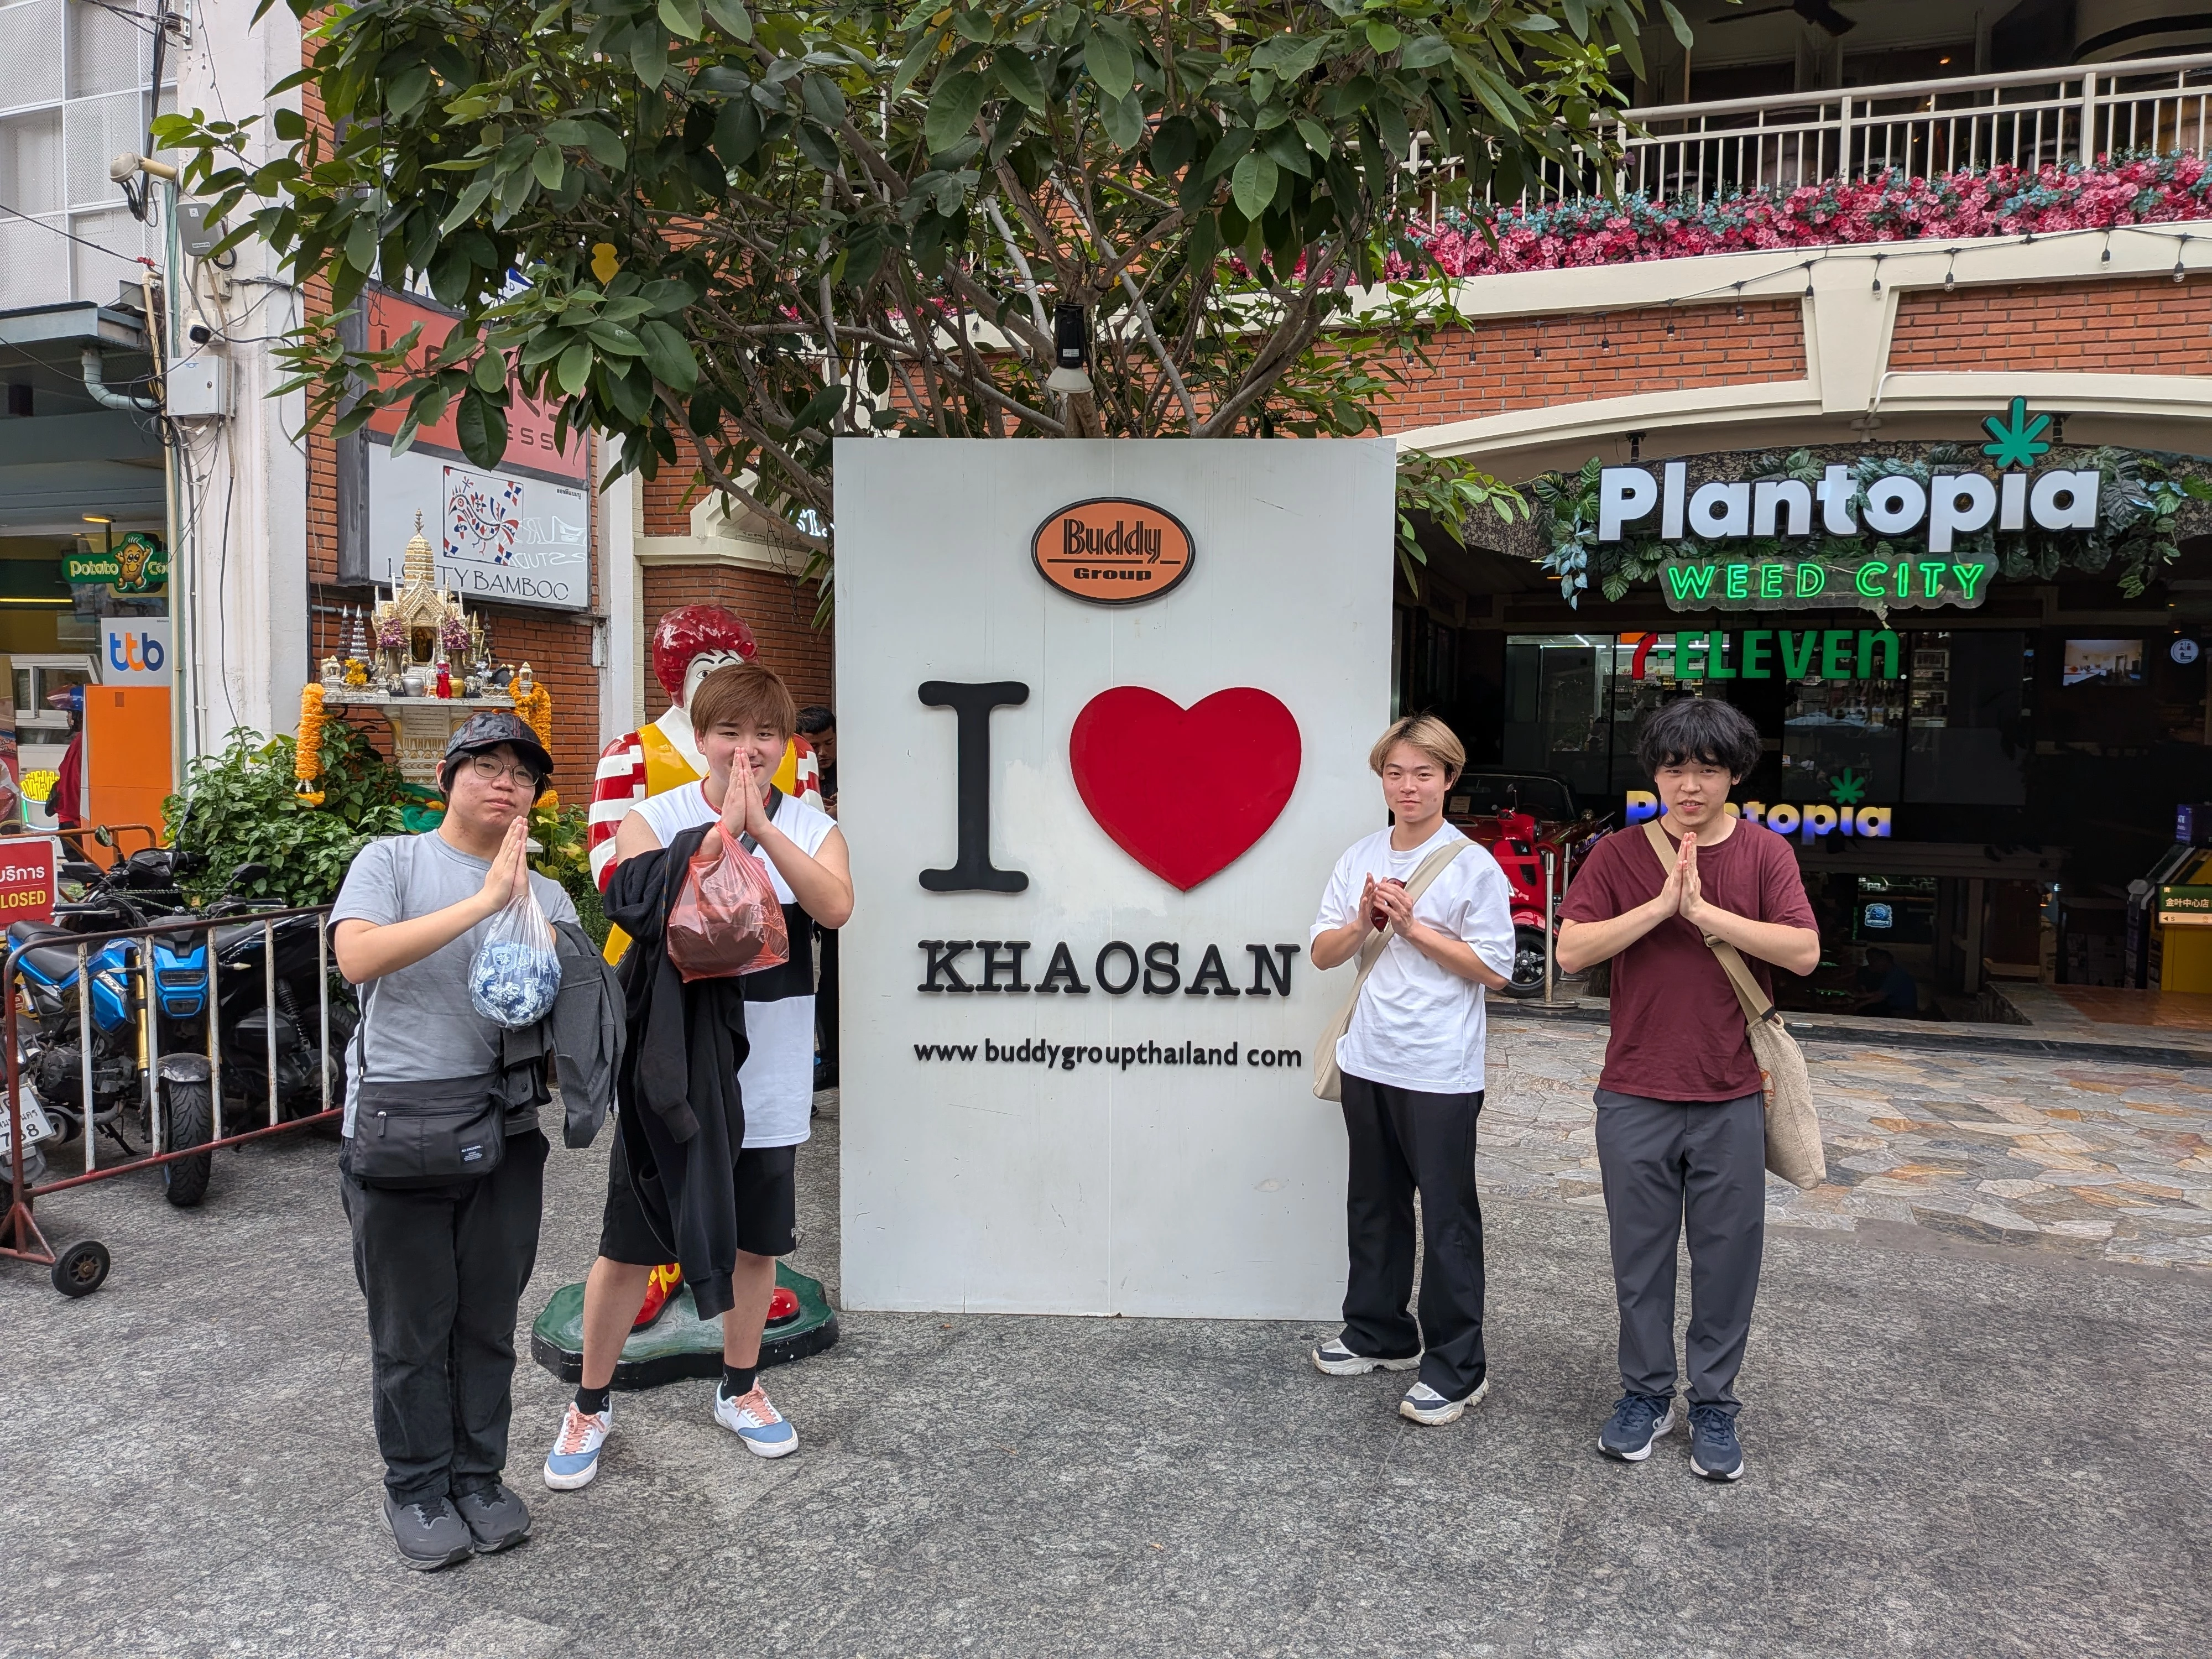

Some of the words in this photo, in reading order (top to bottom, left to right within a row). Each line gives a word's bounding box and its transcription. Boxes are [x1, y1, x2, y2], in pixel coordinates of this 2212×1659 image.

[1599, 462, 2100, 553] Plantopia
[1062, 518, 1161, 564] Buddy
[70, 560, 119, 577] Potato
[1073, 567, 1152, 584] Group
[1668, 562, 1825, 600] WEED
[1855, 561, 1985, 600] CITY
[109, 632, 165, 671] ttb
[917, 680, 1030, 893] I
[1625, 790, 1892, 846] Ptopia
[917, 940, 1301, 997] KHAOSAN
[914, 1042, 978, 1062] www
[985, 1038, 1238, 1071] buddygroupthailand
[1246, 1048, 1302, 1067] com
